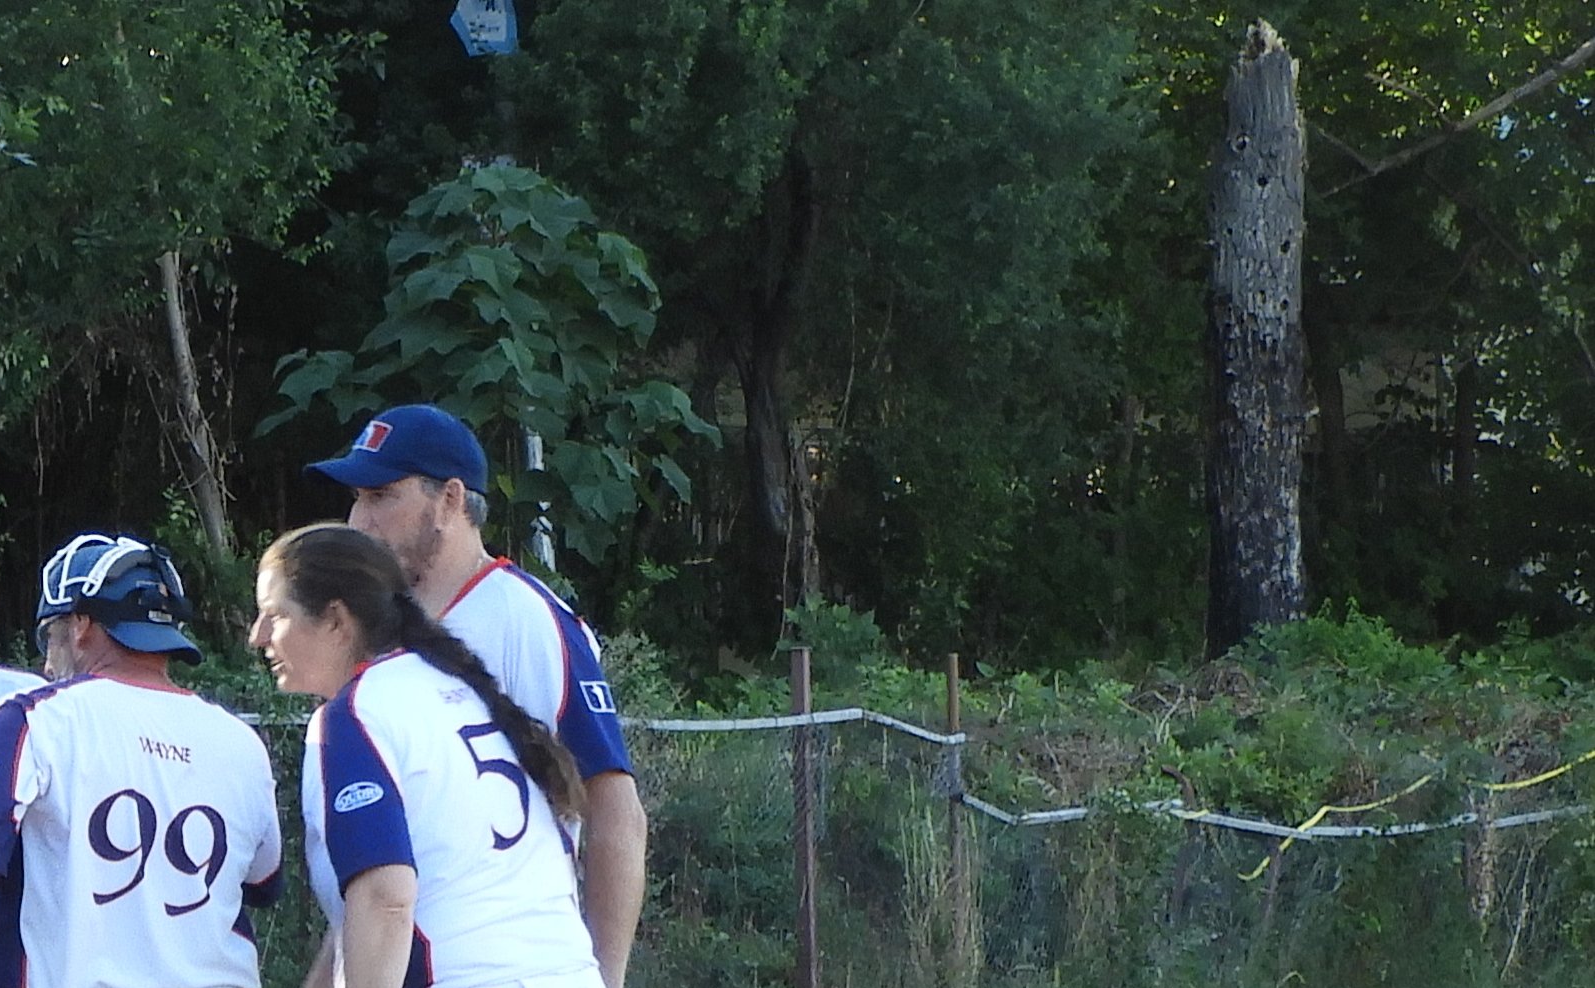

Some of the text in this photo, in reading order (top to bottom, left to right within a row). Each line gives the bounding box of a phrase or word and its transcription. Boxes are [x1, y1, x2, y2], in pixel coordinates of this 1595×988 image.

[138, 736, 192, 764] WAYNE
[457, 721, 531, 851] 5
[87, 788, 229, 917] 99
